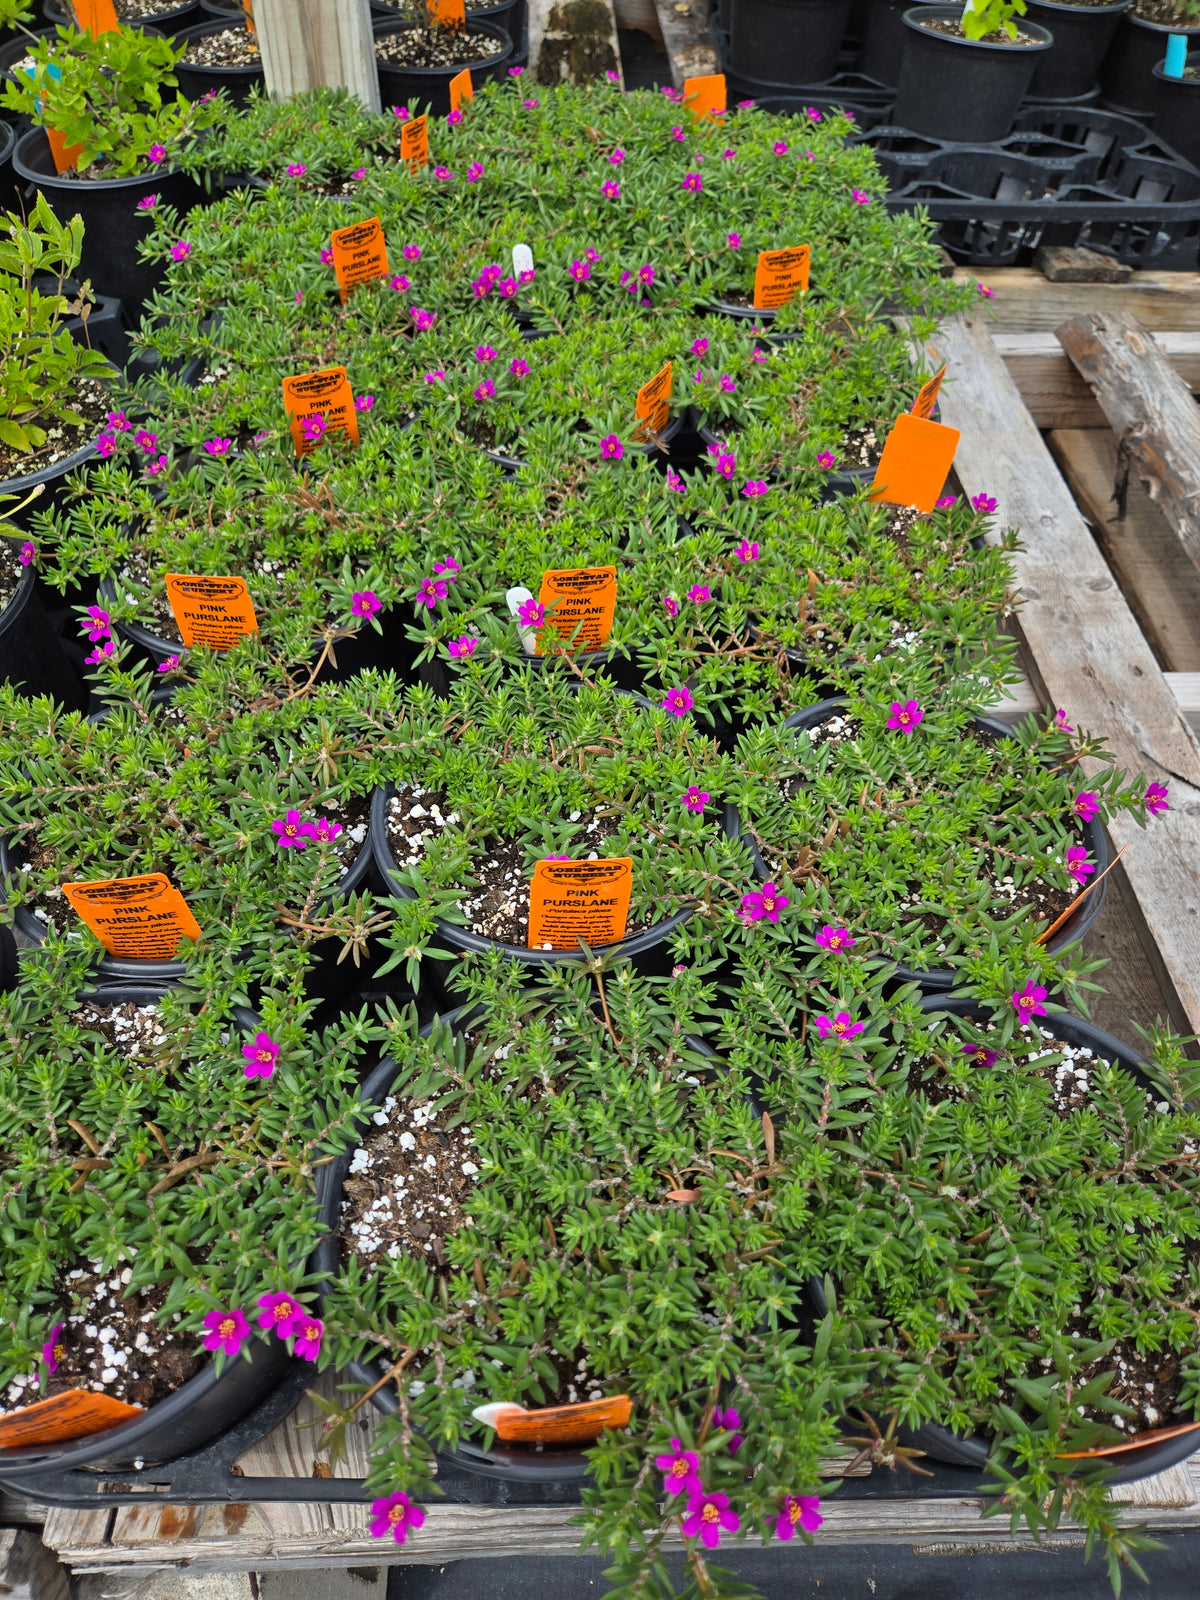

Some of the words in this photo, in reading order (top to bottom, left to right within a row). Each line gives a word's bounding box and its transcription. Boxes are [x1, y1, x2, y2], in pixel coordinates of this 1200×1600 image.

[353, 249, 370, 260] PINK
[342, 254, 380, 272] PURSLANE
[310, 399, 332, 410] PINK
[566, 598, 592, 606] PINK
[199, 604, 227, 613] PINK
[555, 606, 606, 616] URSLANE
[184, 612, 247, 624] PURSLANE
[566, 889, 599, 897] PINK
[543, 898, 619, 907] PURSLANE
[113, 905, 151, 915] PINK
[95, 911, 179, 924] PURSLANE
